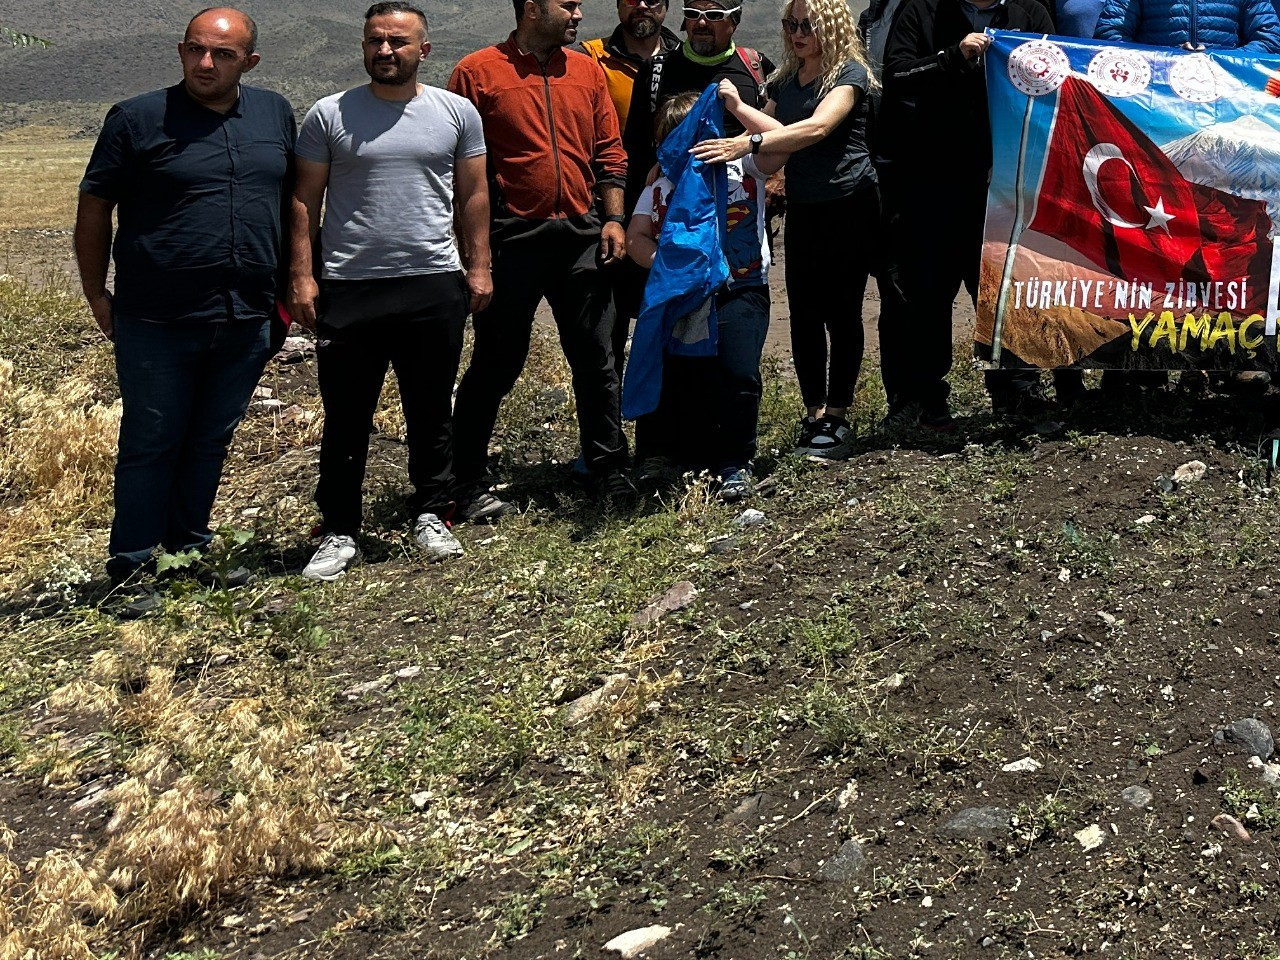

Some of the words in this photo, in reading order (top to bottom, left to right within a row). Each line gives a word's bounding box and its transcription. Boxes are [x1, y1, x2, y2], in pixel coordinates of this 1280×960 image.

[1014, 276, 1154, 311] TÜRKİYE'NİN
[1164, 277, 1248, 311] ZİRVESİ
[1128, 310, 1266, 358] YAMAÇ
